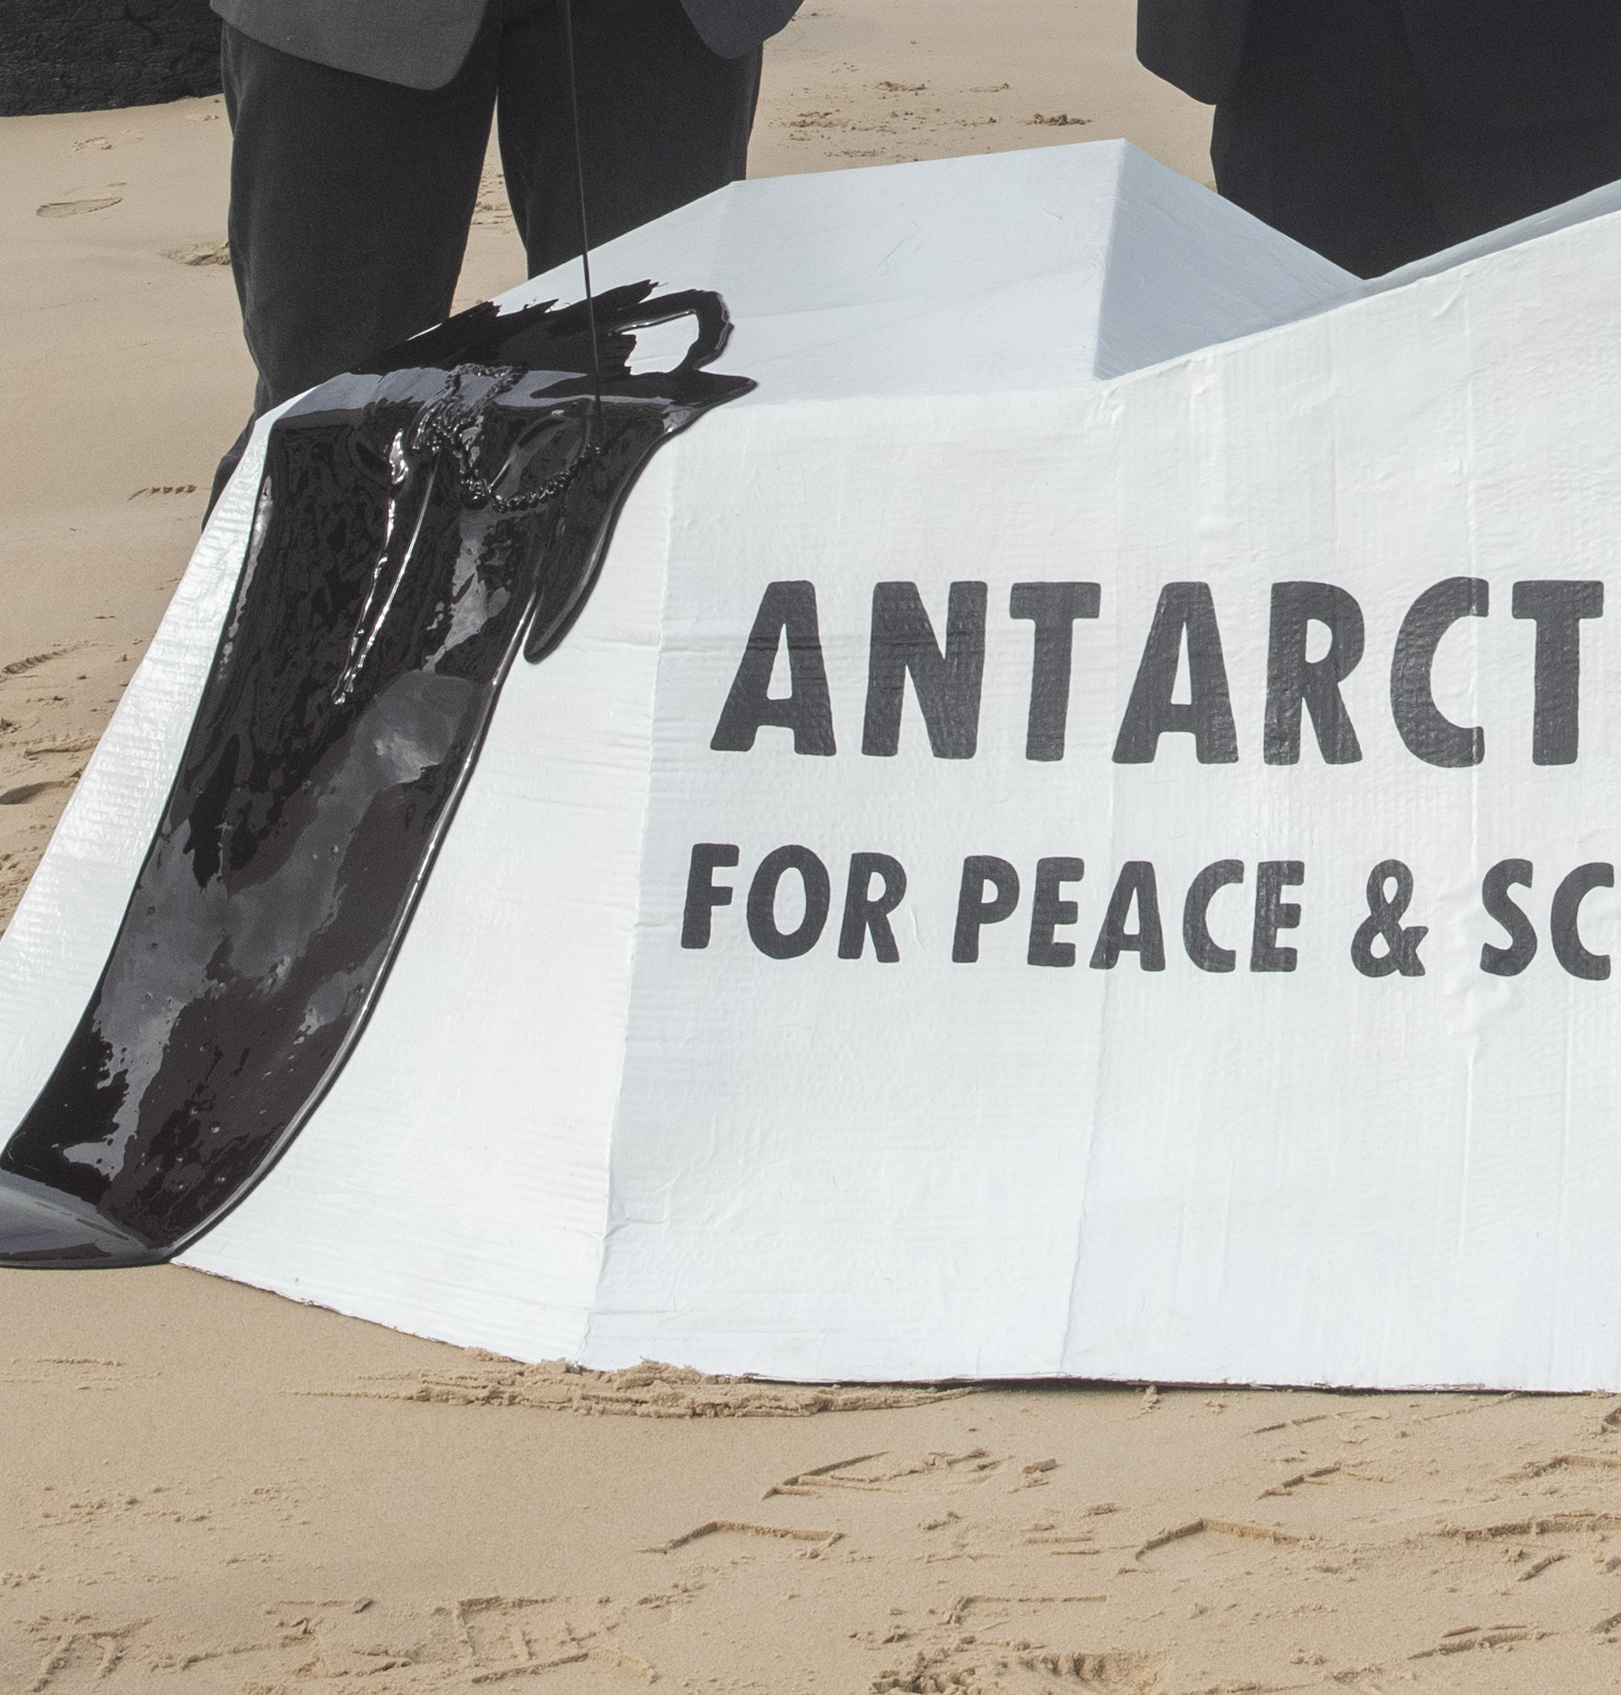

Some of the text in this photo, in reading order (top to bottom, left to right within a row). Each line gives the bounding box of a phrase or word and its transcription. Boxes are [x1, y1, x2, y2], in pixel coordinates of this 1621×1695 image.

[680, 842, 907, 964] FOR
[951, 855, 1305, 973] PEACE
[1350, 859, 1429, 978] &
